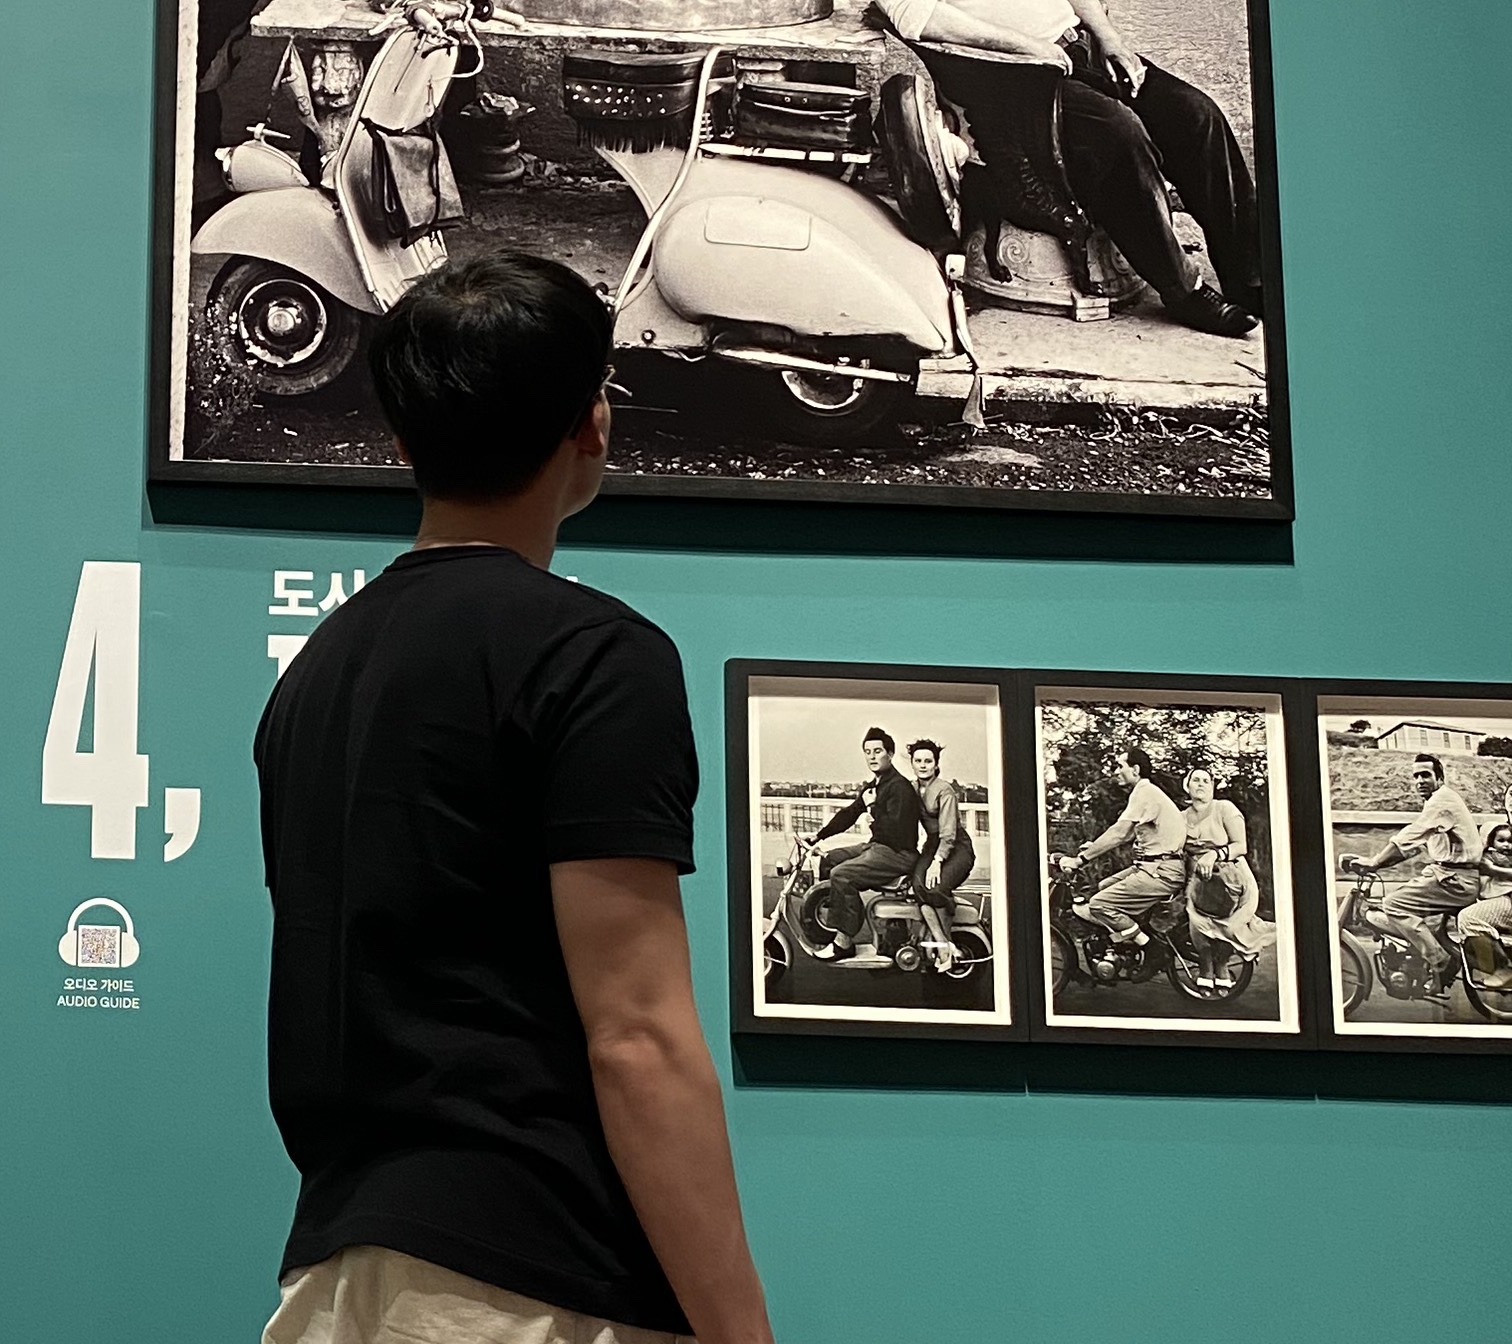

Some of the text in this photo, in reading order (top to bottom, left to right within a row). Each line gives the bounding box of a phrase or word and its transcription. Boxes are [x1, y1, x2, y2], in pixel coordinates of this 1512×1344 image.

[63, 977, 134, 993] 오디오 가이드
[56, 996, 140, 1009] AUDIO GUIDE
